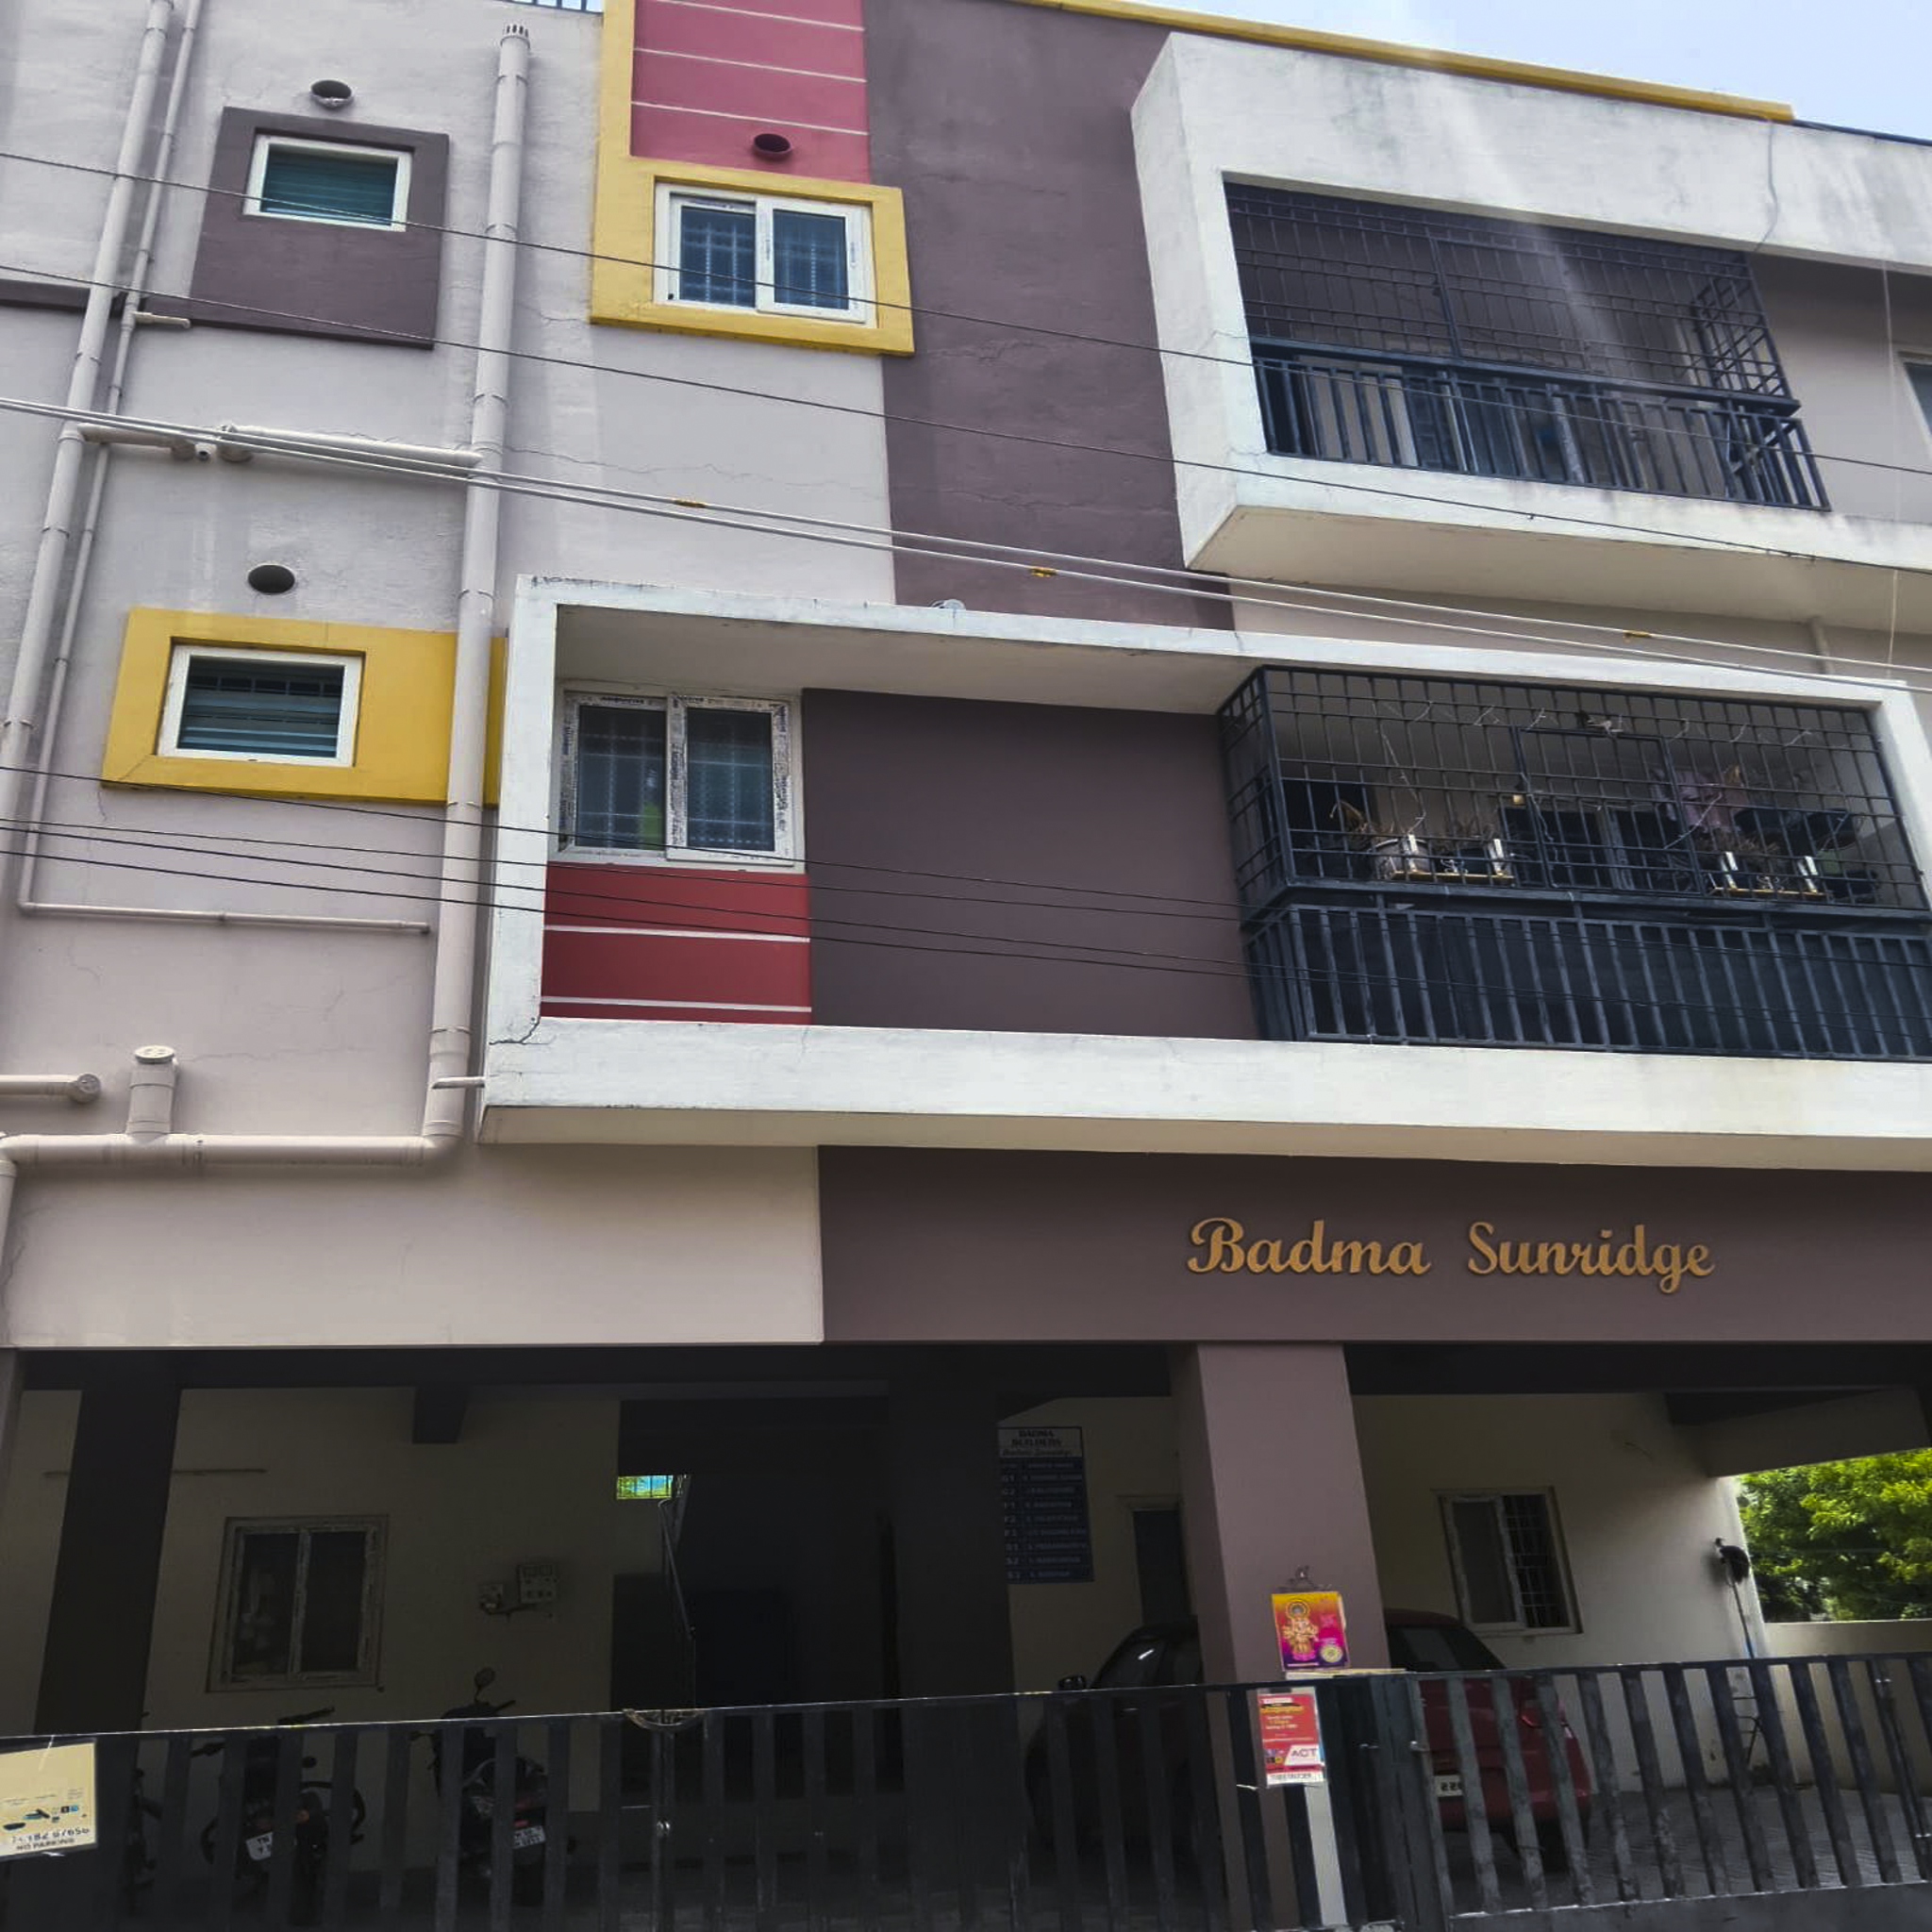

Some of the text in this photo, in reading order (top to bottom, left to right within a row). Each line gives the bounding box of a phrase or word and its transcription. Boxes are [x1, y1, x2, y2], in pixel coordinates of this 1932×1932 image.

[1187, 1217, 1715, 1293] Badma Sunridge
[1291, 1748, 1317, 1757] ACT
